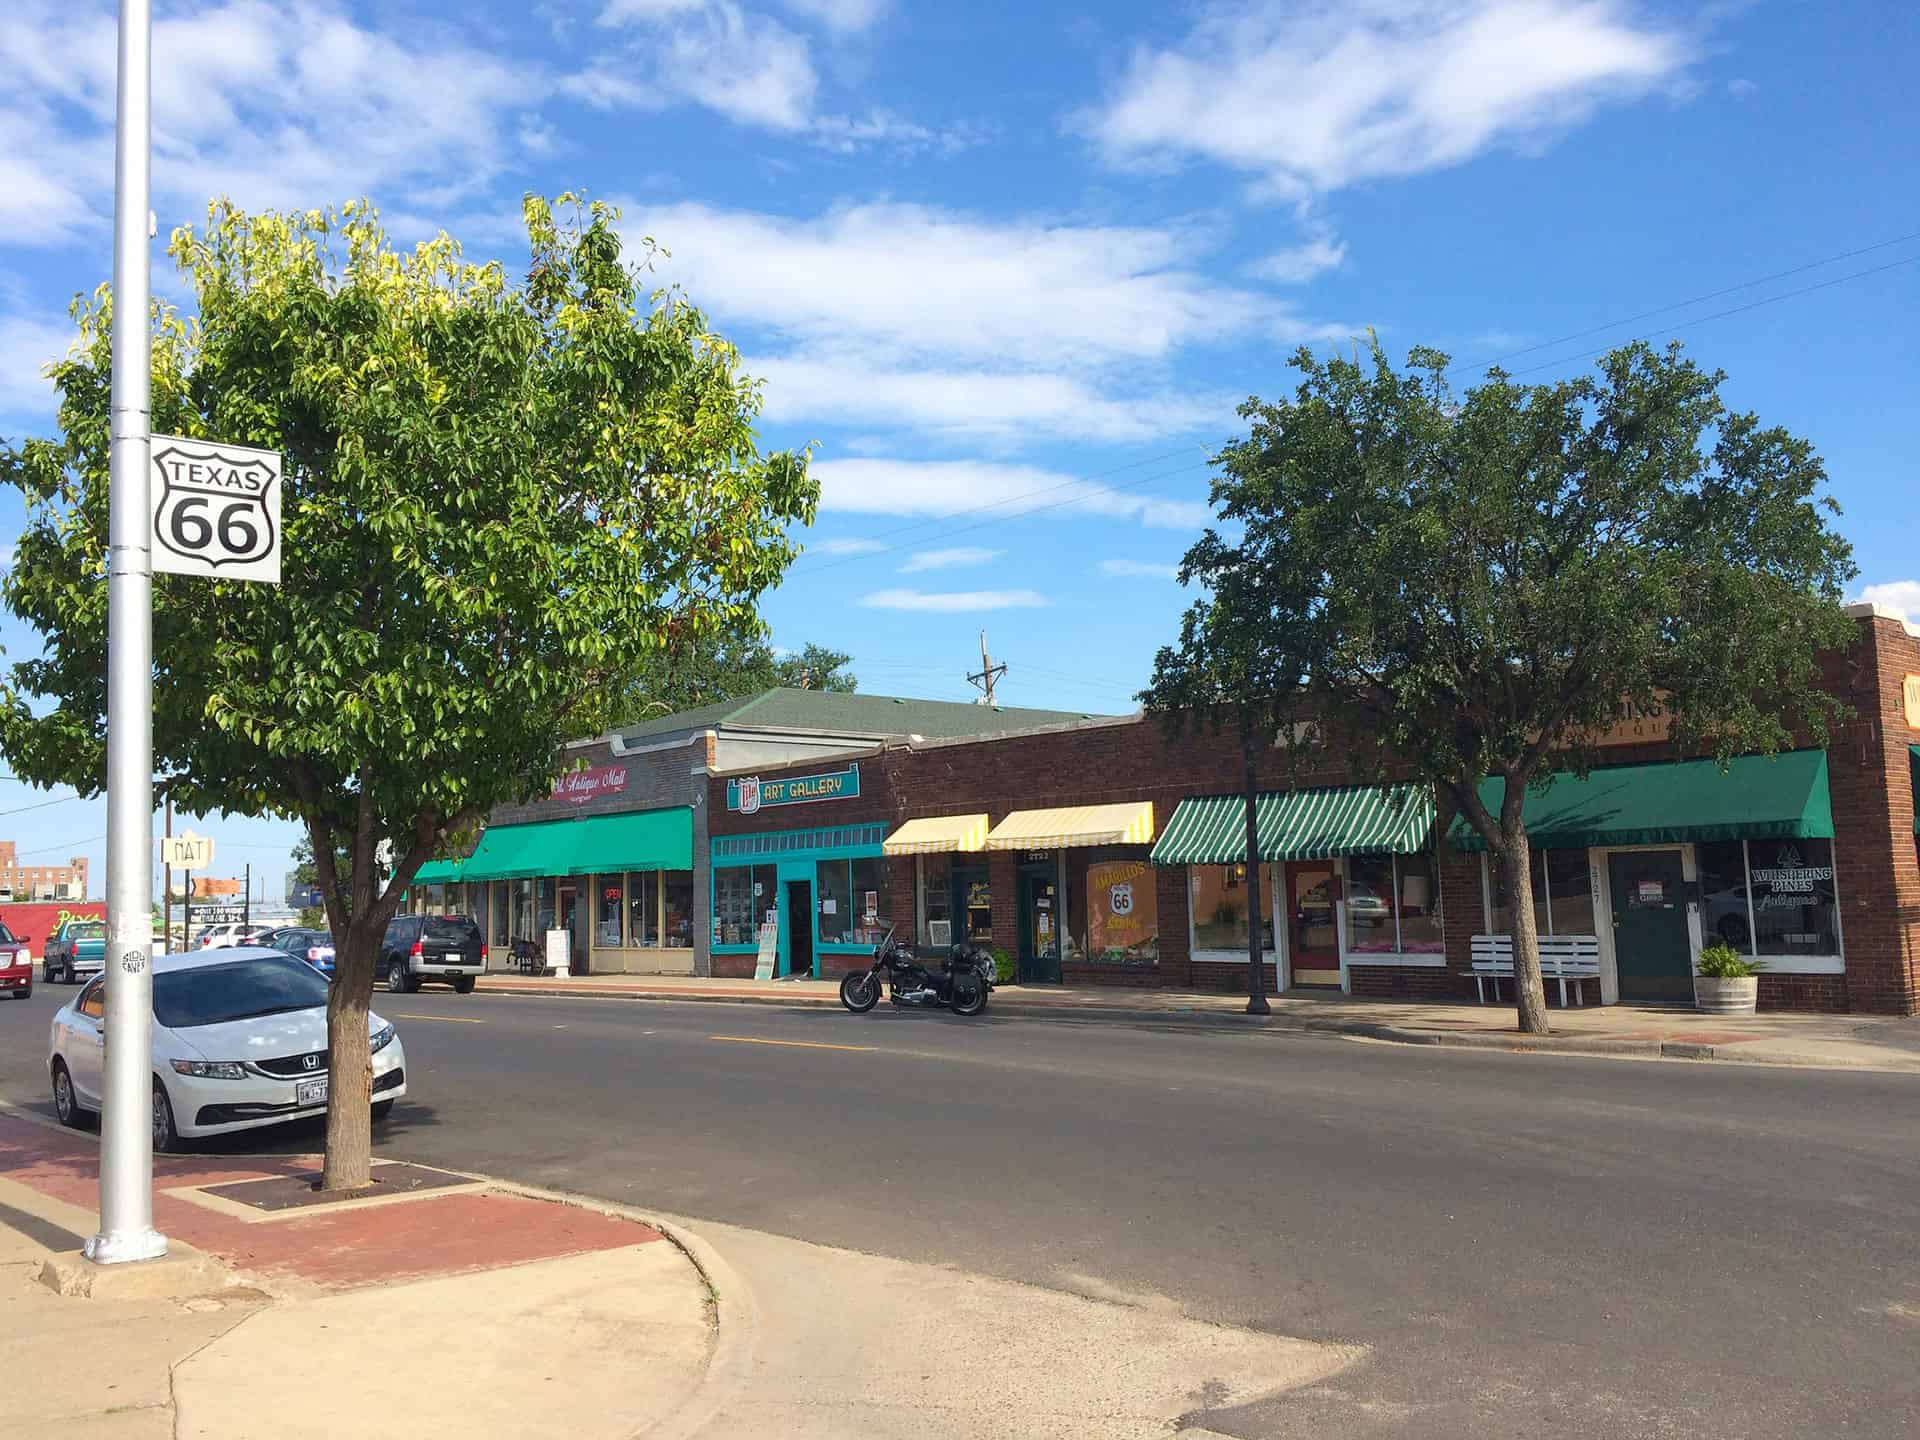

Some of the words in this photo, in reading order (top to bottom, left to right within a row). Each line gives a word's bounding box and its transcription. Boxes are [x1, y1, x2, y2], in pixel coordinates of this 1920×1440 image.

[168, 461, 261, 491] TEXAS
[171, 497, 258, 554] 66
[602, 768, 626, 788] Mall
[764, 784, 784, 800] ART
[789, 778, 841, 798] GALLERY
[1752, 866, 1832, 881] WHISPERING
[1771, 880, 1814, 892] PINES
[1113, 893, 1129, 909] 66
